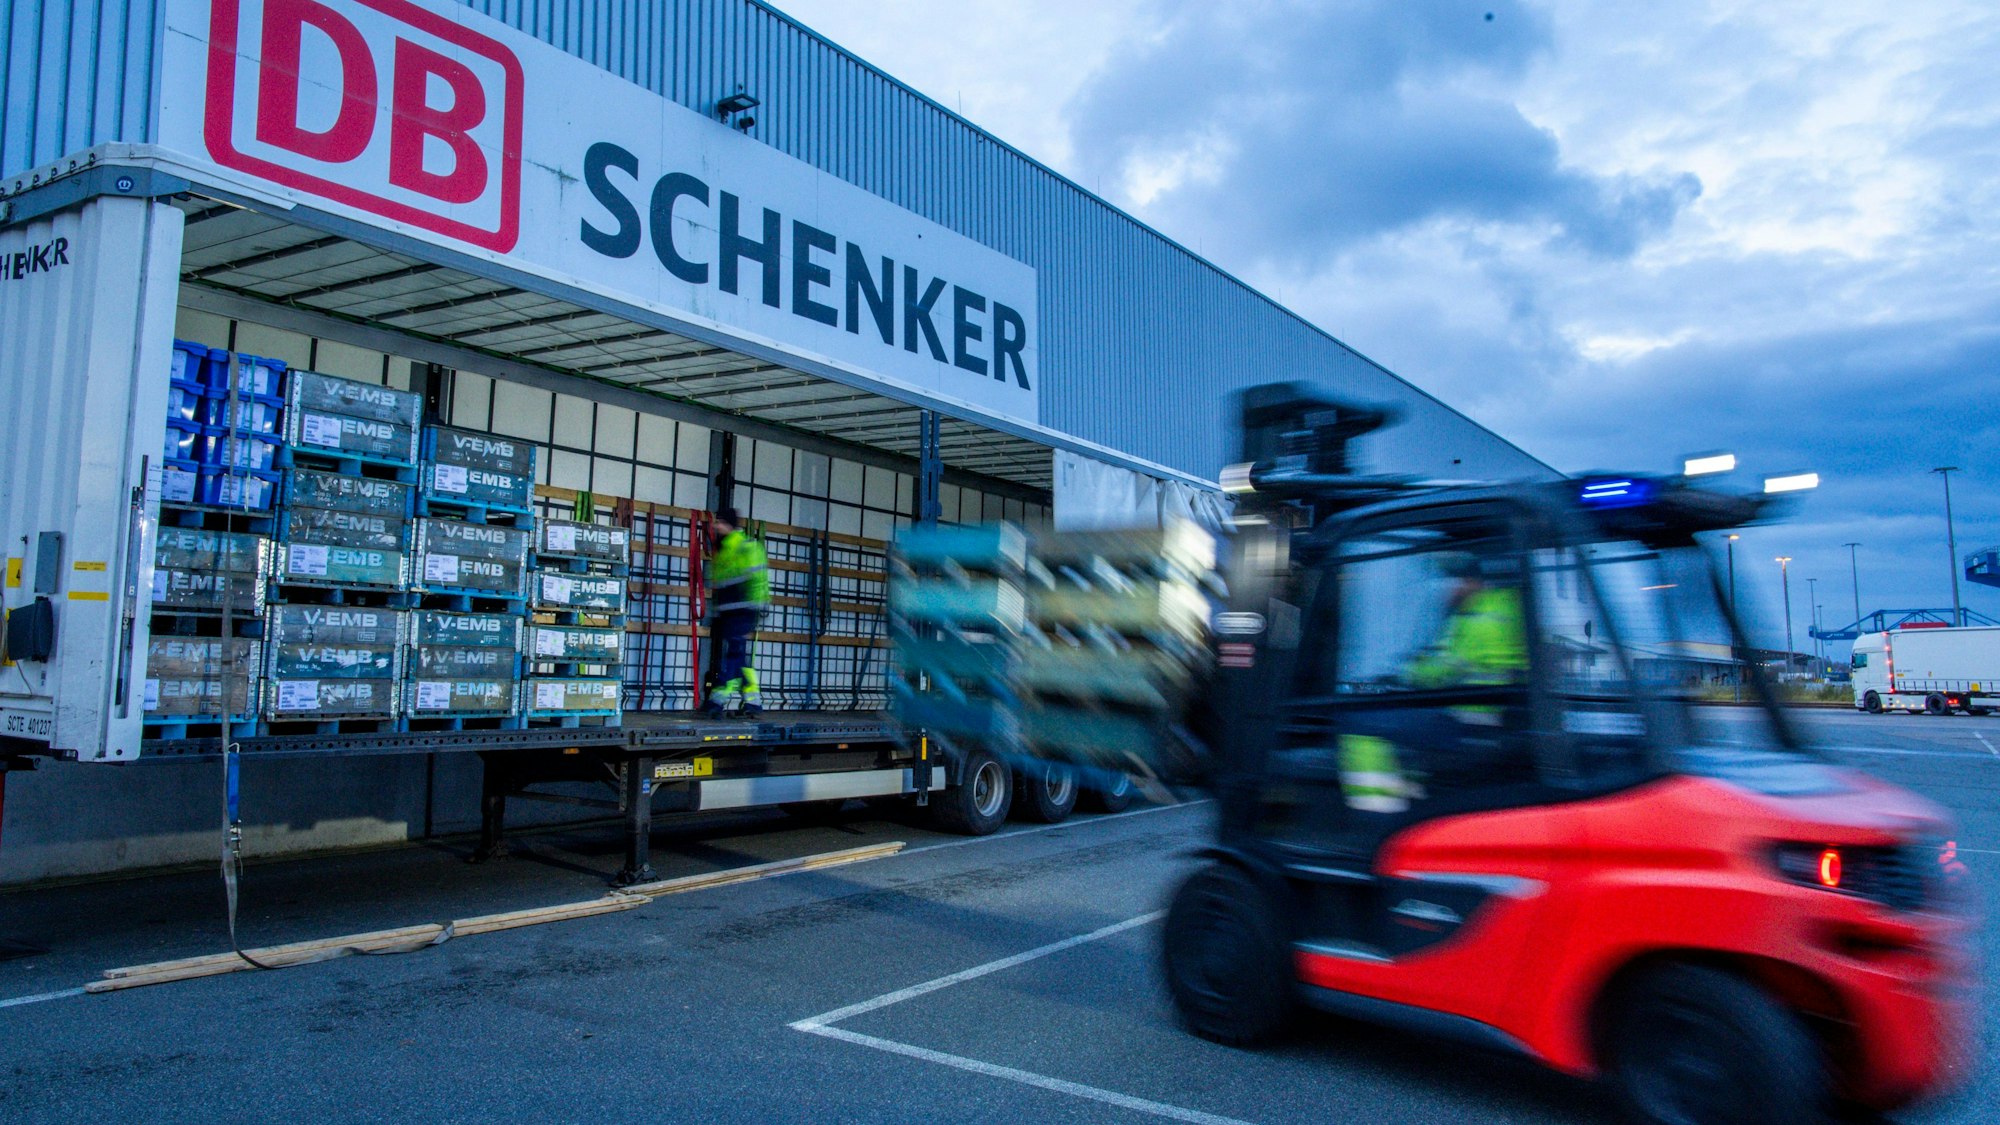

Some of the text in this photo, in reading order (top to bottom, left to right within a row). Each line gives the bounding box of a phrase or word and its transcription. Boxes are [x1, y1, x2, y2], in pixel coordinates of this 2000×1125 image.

[256, 0, 1031, 390] DB SCHENKER
[323, 381, 396, 407] V-EMB
[342, 420, 392, 439] EMB
[453, 434, 514, 457] V-EMB
[468, 470, 512, 488] EMB
[444, 524, 506, 544] V-EMB
[575, 529, 610, 544] EMB
[459, 560, 504, 577] EMB
[570, 580, 607, 594] EMB
[303, 608, 378, 627] V-EMB
[437, 616, 500, 632] V-EMB
[298, 648, 373, 664] V-EMB
[434, 650, 498, 665] V-EMB
[8, 715, 51, 736] SCTE 401237
